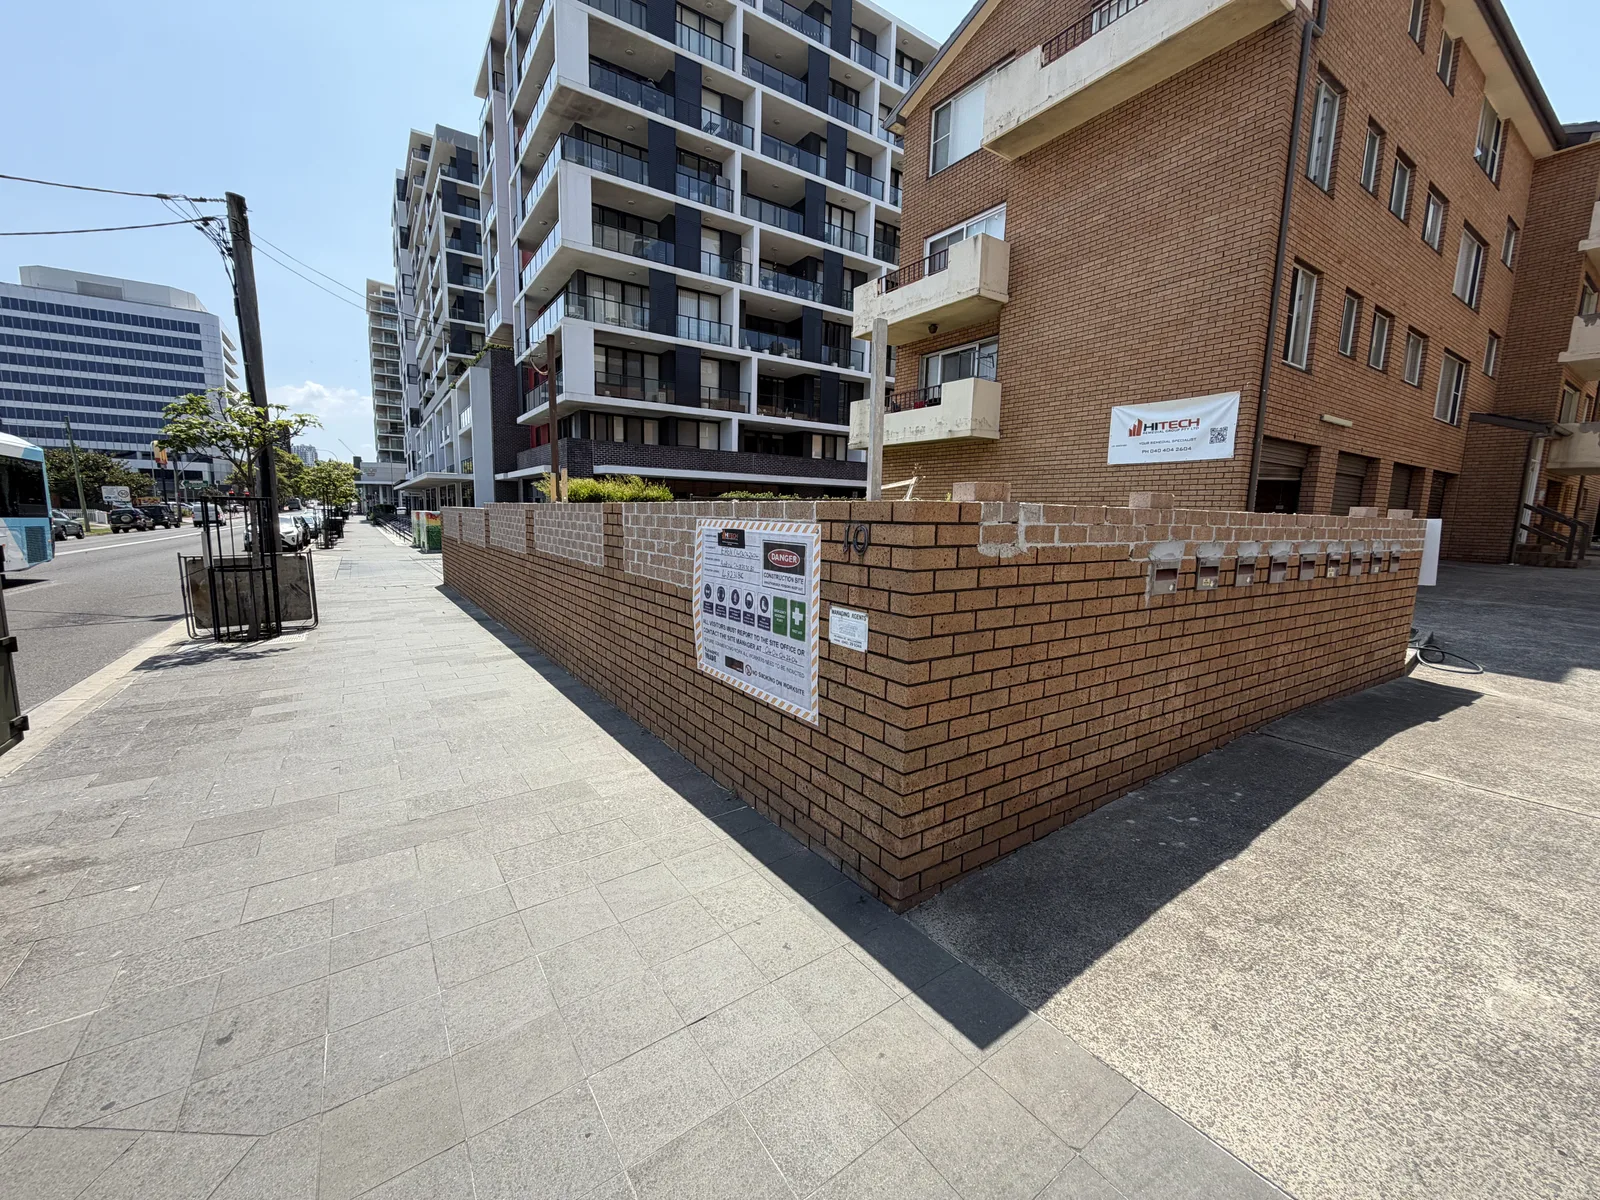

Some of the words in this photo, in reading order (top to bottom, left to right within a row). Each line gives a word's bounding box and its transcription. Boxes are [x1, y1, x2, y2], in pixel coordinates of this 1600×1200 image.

[1144, 418, 1200, 431] HITECH
[771, 553, 797, 563] DANGER
[764, 572, 794, 582] CONSTRUCTION
[710, 620, 726, 629] VISITORS
[737, 629, 753, 638] REPORT
[769, 639, 778, 647] SITE
[780, 643, 796, 653] OFFICE
[797, 648, 805, 656] OR
[736, 637, 756, 649] MANAGER
[758, 672, 775, 684] SMOKING
[783, 682, 804, 696] WORKSITE
